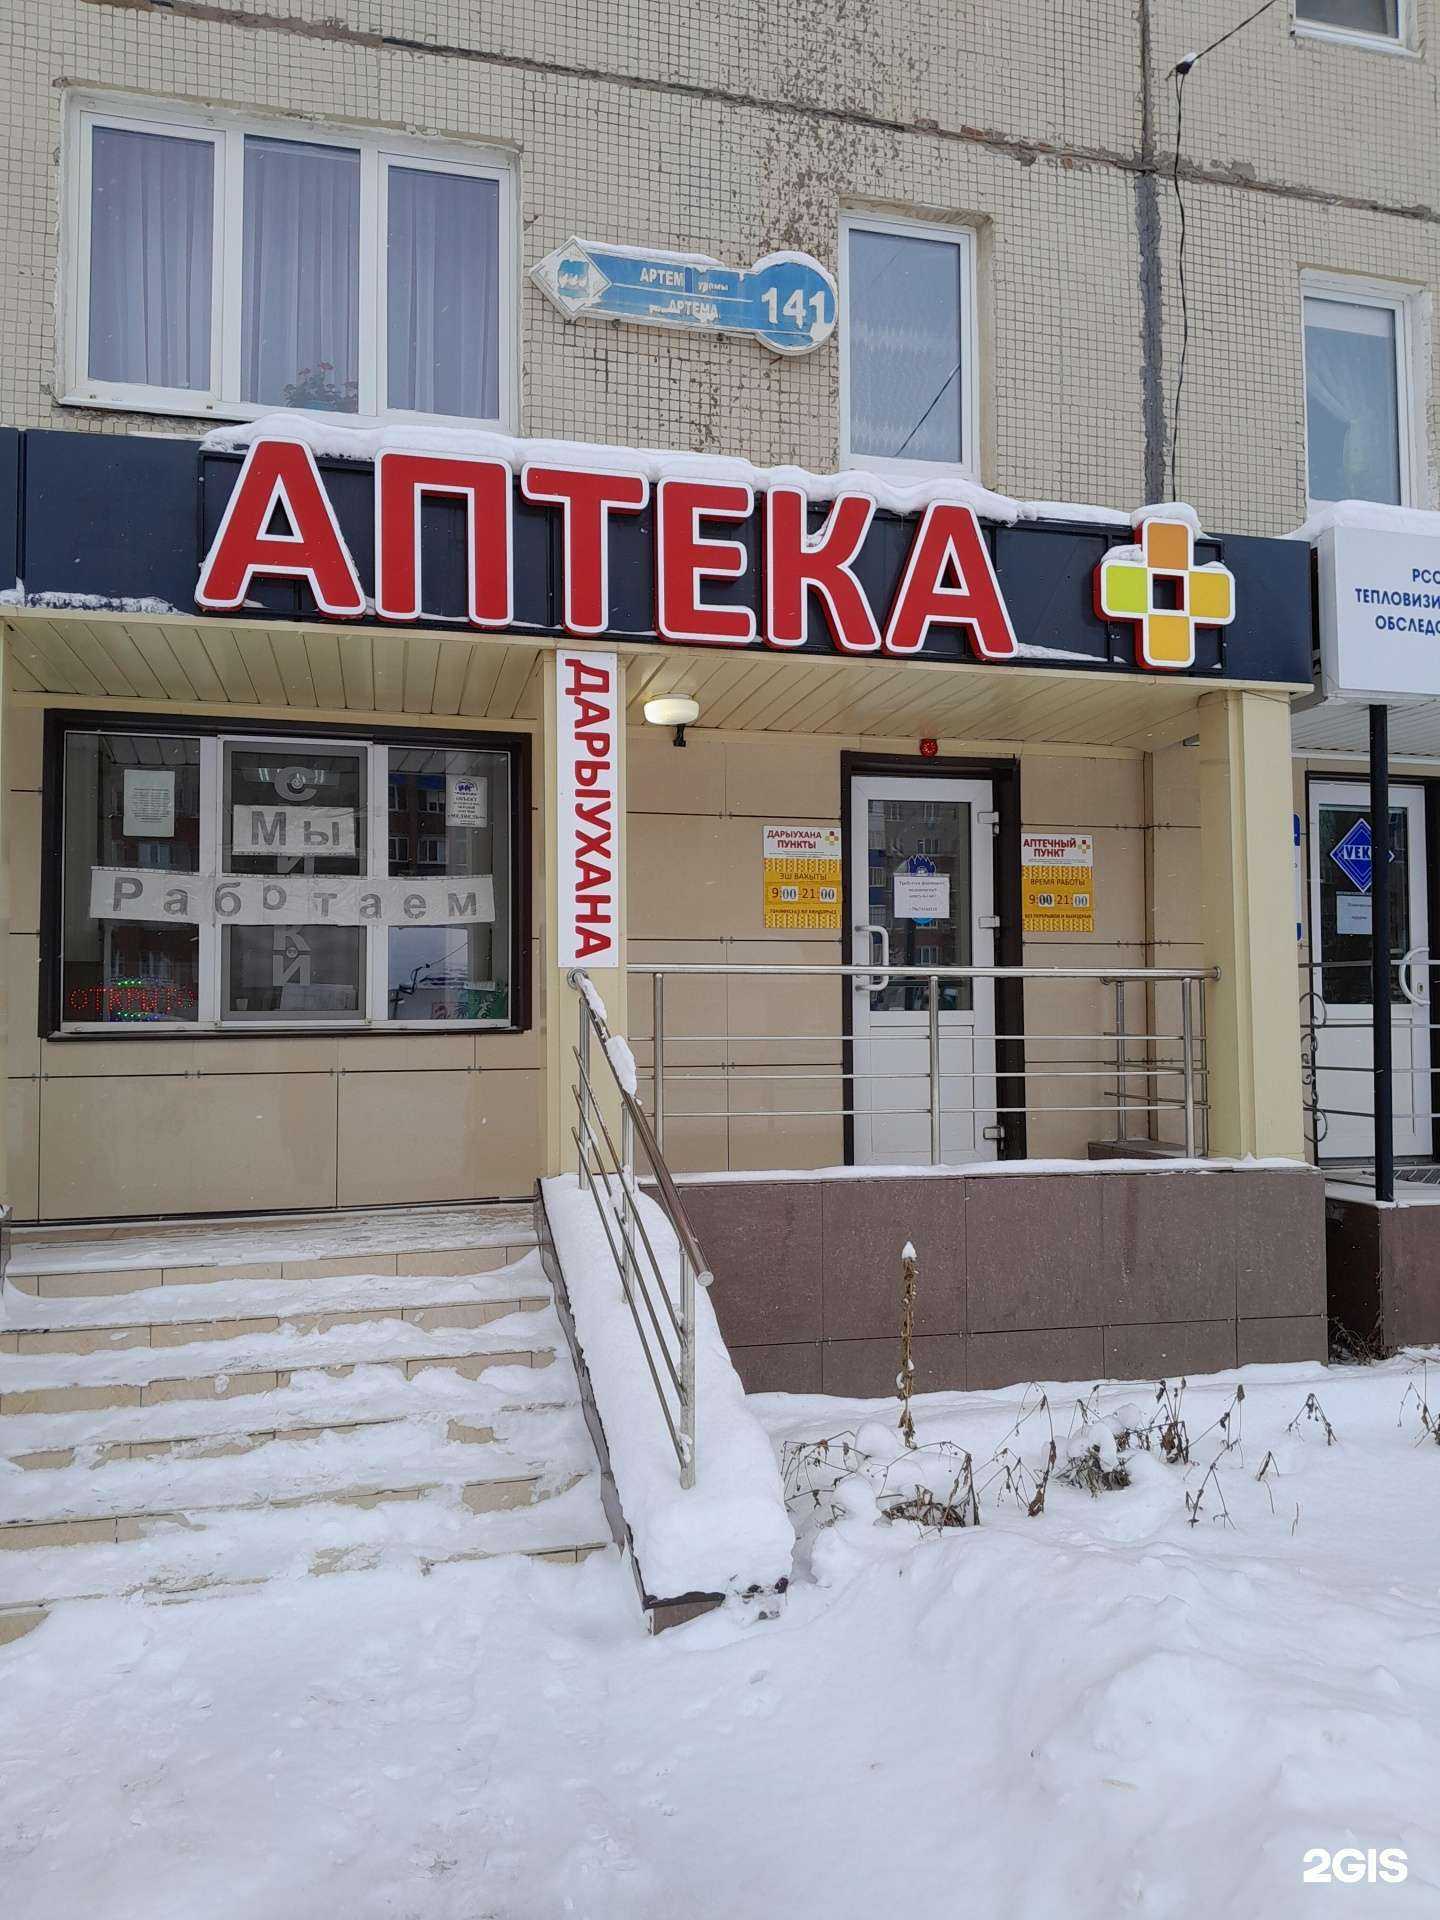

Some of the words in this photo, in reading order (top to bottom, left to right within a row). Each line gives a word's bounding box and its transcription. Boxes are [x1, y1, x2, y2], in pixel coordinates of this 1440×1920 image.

[761, 287, 826, 328] 141
[195, 436, 1020, 661] АПТЕКА
[565, 658, 612, 959] ДАРЫУХАНА
[251, 810, 340, 846] Мы
[767, 830, 822, 839] ДАРЫУХАНА
[777, 840, 817, 849] ПУНКТЫ
[1023, 837, 1077, 848] АПТЕЧНЫЙ
[1033, 849, 1066, 858] ПУНКТ
[1345, 846, 1371, 859] VEK
[1056, 879, 1086, 887] РАБОТЫ
[111, 876, 478, 918] Работаем
